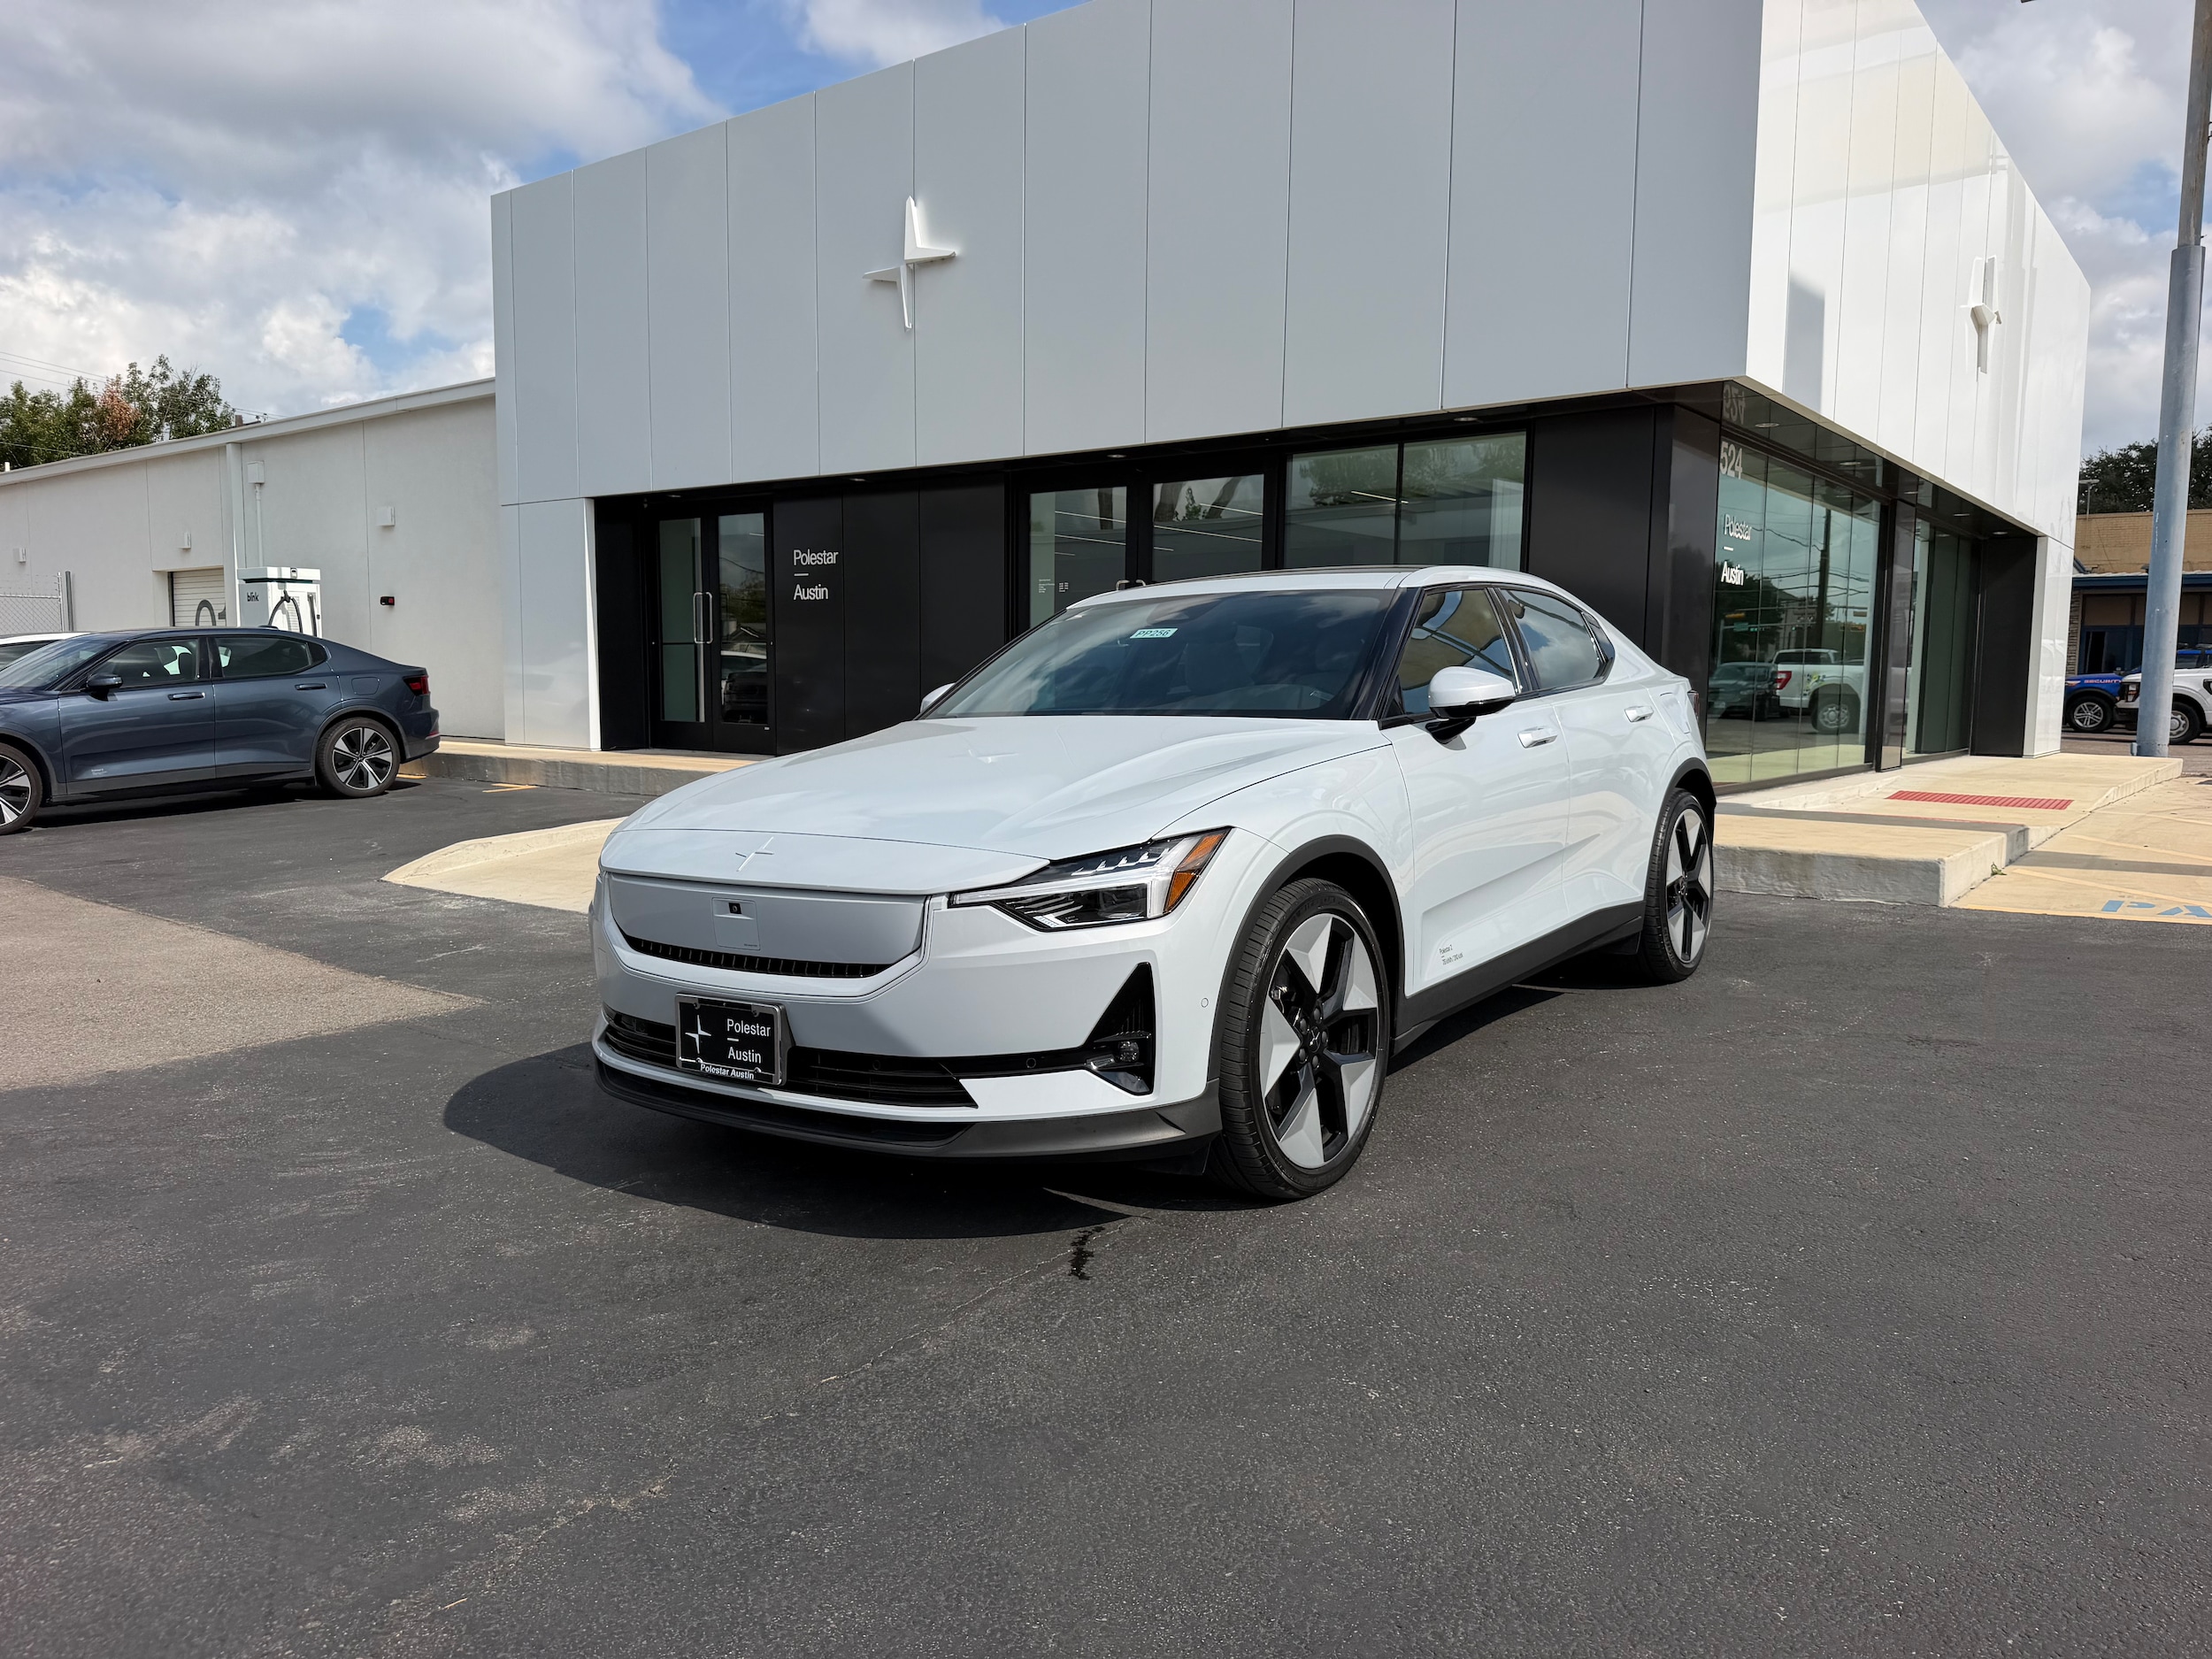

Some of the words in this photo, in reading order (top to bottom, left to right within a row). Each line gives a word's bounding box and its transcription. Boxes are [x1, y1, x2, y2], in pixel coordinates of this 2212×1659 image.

[1719, 441, 1743, 480] 524
[1724, 513, 1752, 541] Polestar
[793, 549, 839, 565] Polestar
[1721, 561, 1745, 586] Austin
[793, 583, 829, 600] Austin
[726, 1018, 772, 1038] Polestar
[727, 1047, 762, 1064] Austin
[700, 1064, 730, 1077] Polestar
[730, 1068, 755, 1080] Austin
